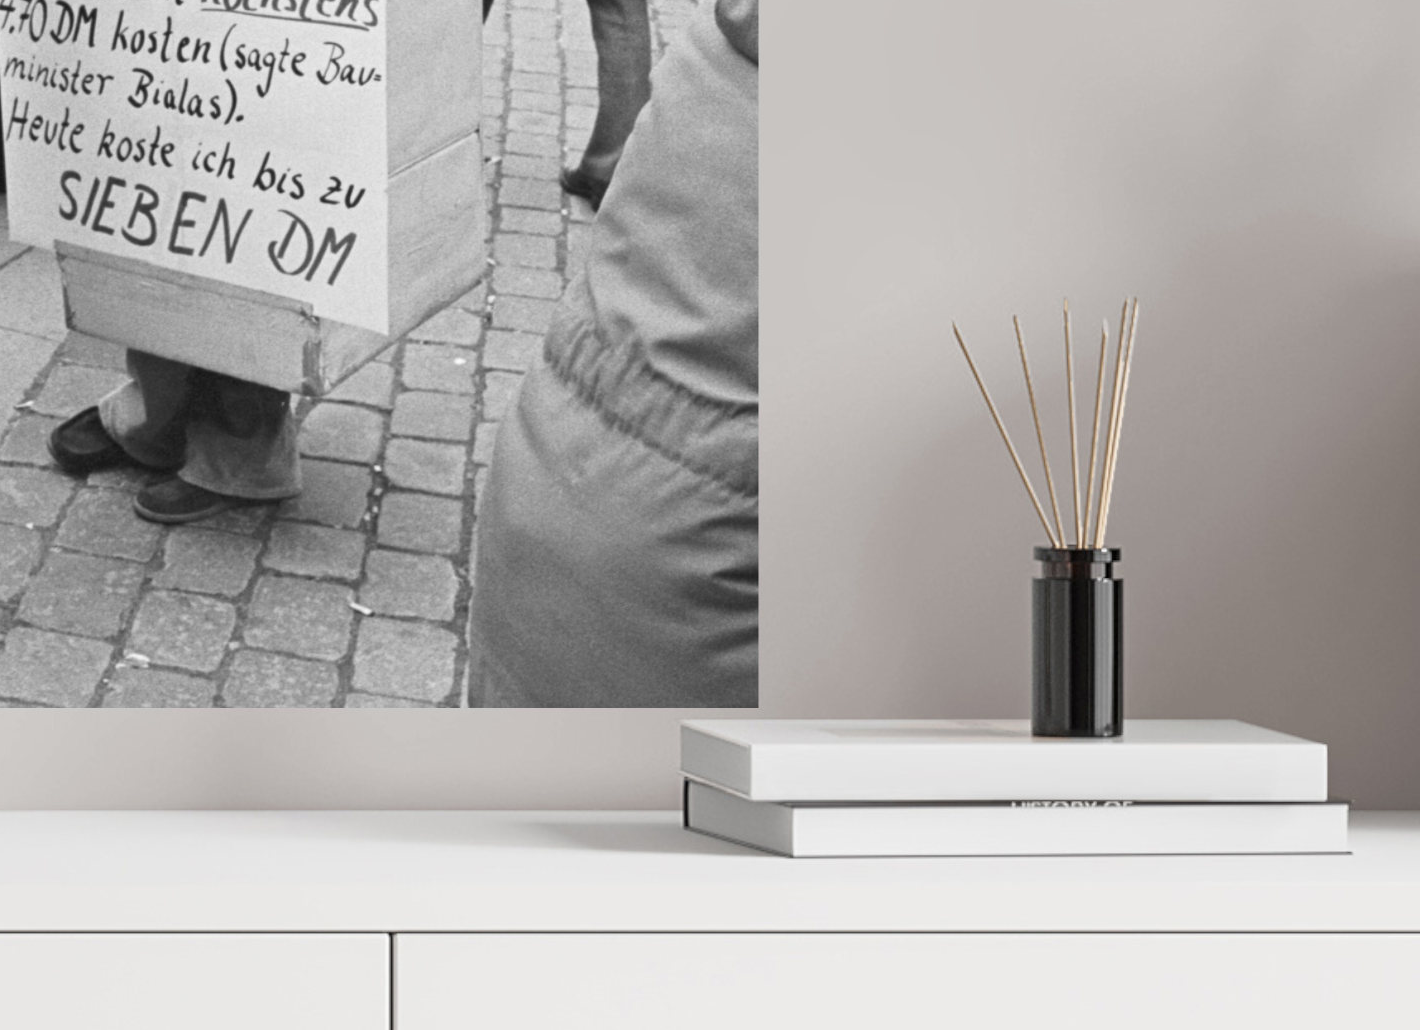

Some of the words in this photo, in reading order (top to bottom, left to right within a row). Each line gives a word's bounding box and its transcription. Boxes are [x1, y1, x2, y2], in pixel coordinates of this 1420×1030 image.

[4, 55, 114, 95] minister
[128, 67, 244, 124] Bialas).
[51, 0, 98, 48] DM
[112, 10, 211, 64] kosten
[220, 23, 306, 98] (sagte
[6, 96, 84, 154] Heute
[97, 118, 174, 168] koste
[192, 141, 236, 180] ich
[253, 151, 305, 200] bis
[320, 175, 365, 209] zu
[58, 169, 253, 264] SIEBEN
[268, 208, 357, 286] DM
